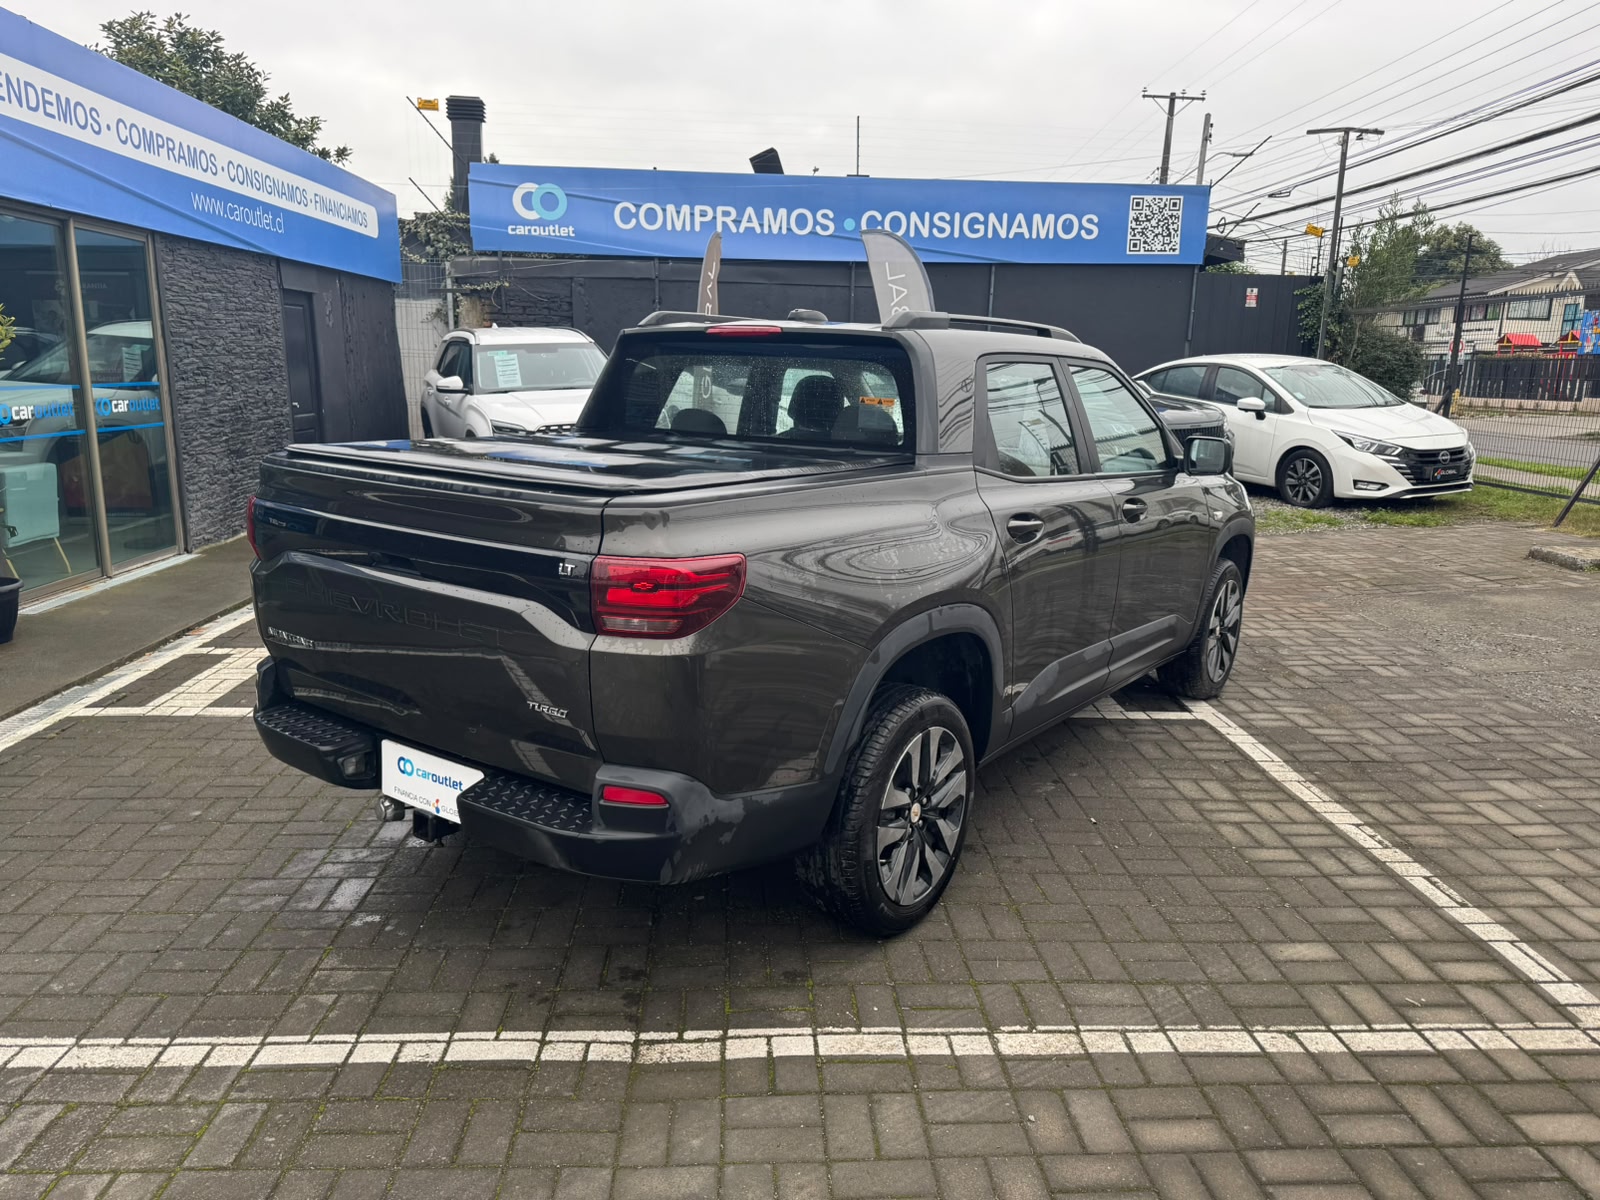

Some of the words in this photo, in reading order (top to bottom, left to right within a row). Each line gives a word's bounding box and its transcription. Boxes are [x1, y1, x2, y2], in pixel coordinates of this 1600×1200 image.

[0, 71, 101, 135] NDEMOS
[116, 118, 218, 176] COMPRAMOS
[227, 160, 308, 207] CONSIGNAMOS
[314, 197, 368, 228] FINANCIAMOS
[191, 192, 285, 233] www.caroutlet.cl
[614, 202, 835, 235] COMPRAMOS
[859, 209, 1099, 240] CONSIGNAMOS
[507, 223, 575, 237] caroutlet
[11, 400, 75, 420] caroutlet
[111, 396, 161, 413] caroutlet
[558, 562, 575, 576] LT
[416, 768, 463, 791] caroutlet
[394, 786, 418, 800] FINANCIA
[418, 796, 431, 807] CON
